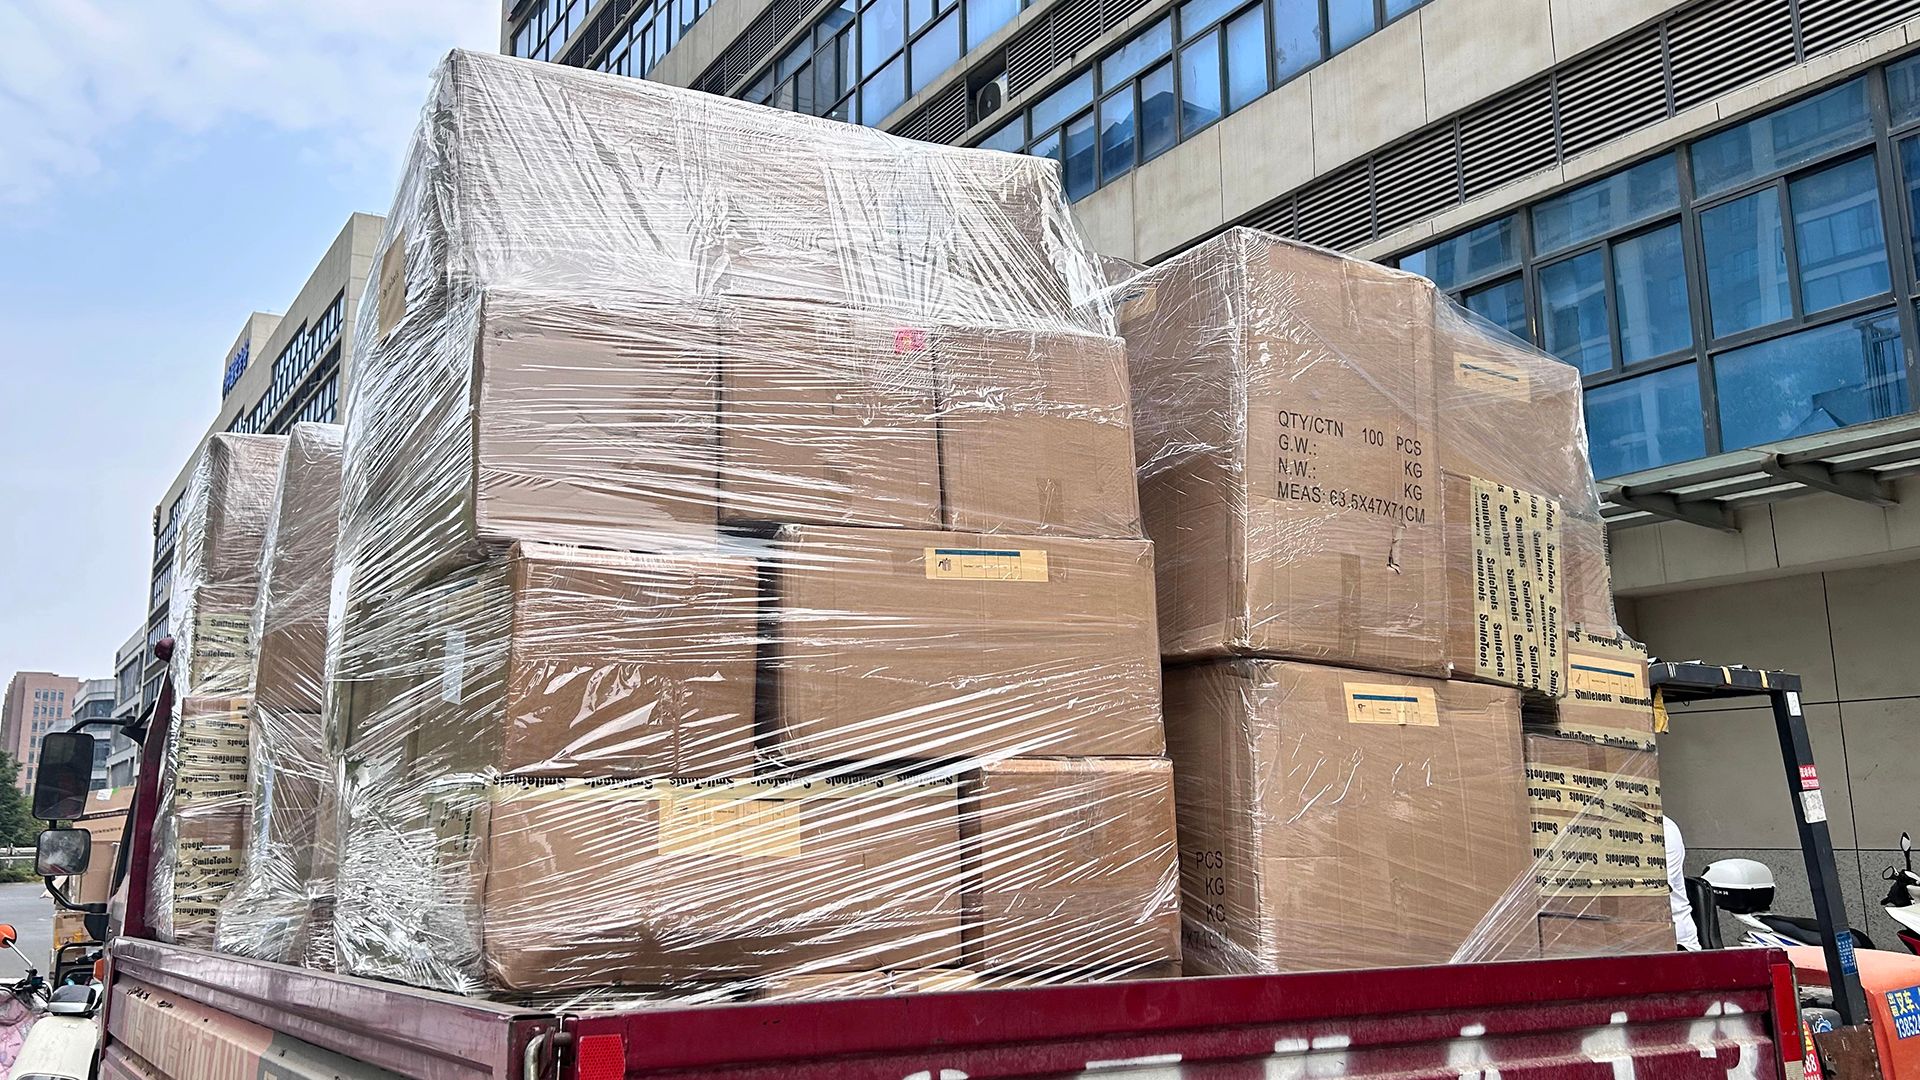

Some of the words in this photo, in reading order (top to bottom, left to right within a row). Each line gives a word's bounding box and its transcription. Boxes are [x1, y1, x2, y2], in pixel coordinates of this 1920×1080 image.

[1278, 411, 1344, 438] QTY/CTN
[1362, 428, 1384, 447] 100
[1396, 436, 1422, 456] PCS
[1279, 434, 1317, 455] G.W.:
[1405, 461, 1422, 478] KG
[1278, 457, 1316, 479] N.W.:
[1404, 483, 1422, 500] KG
[1480, 614, 1489, 667] SmileTools
[1493, 623, 1505, 677] SmileTools
[1196, 851, 1223, 869] PCS
[1206, 877, 1225, 896] KG
[1206, 904, 1226, 922] KG
